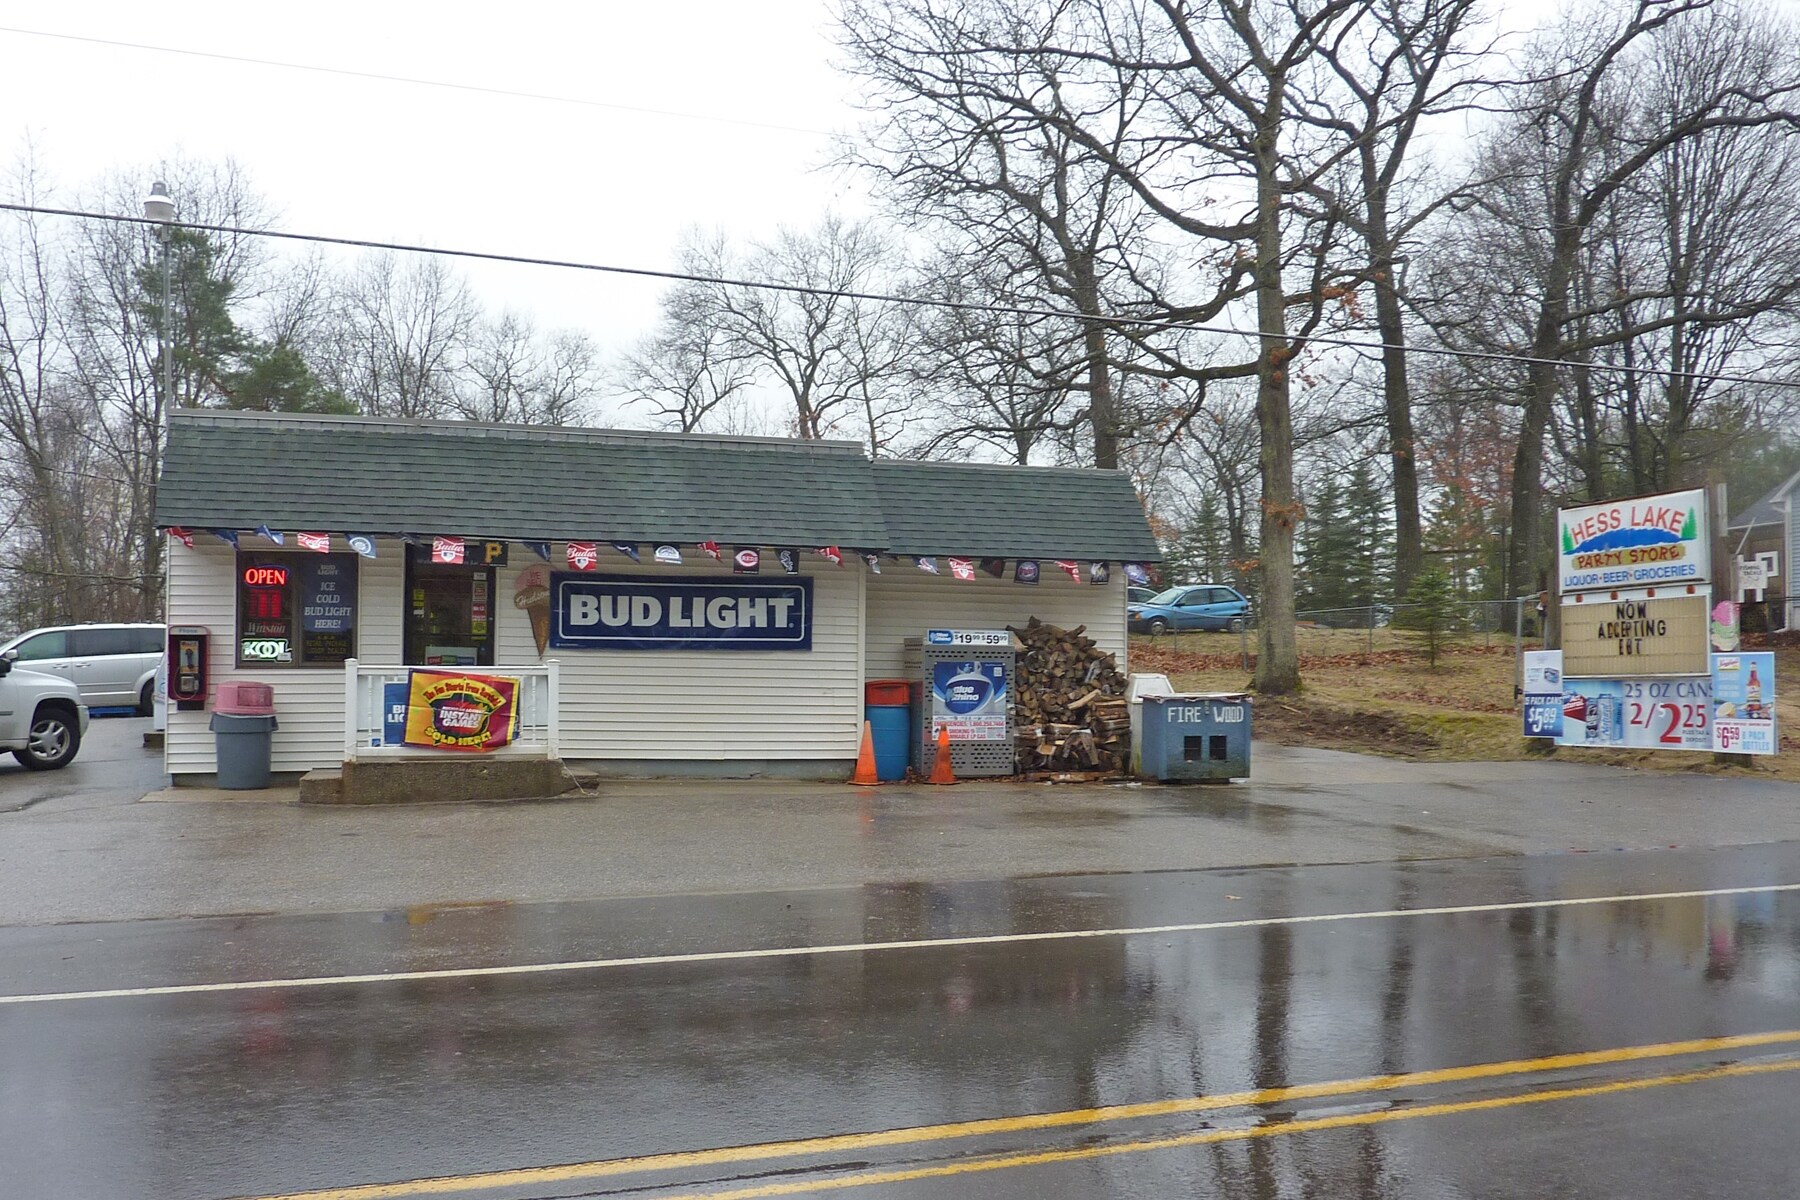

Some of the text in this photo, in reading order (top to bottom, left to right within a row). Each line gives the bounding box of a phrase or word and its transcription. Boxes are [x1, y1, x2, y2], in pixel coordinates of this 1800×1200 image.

[1572, 506, 1685, 545] HESS LAKE
[1577, 545, 1680, 569] PARTY STORE
[245, 568, 286, 585] OPEN
[1565, 563, 1696, 587] LIQUOR BEER GROCERIES
[321, 582, 336, 591] ICE
[316, 594, 340, 603] COLD
[304, 607, 352, 616] BUD LIGHT
[569, 594, 795, 629] BUD LIGHT
[1616, 602, 1647, 620] NOW
[248, 622, 286, 634] Winston
[314, 620, 341, 629] HERE!
[1598, 620, 1666, 639] ACCEPTING
[242, 641, 289, 658] KOOL
[1619, 638, 1643, 655] EBT
[1624, 683, 1642, 698] 25
[1649, 682, 1669, 698] OZ
[440, 709, 482, 720] INSTANT
[1167, 705, 1245, 723] FIRE WOOD
[442, 719, 479, 727] GAMES
[425, 727, 492, 746] SOLD HERE!
